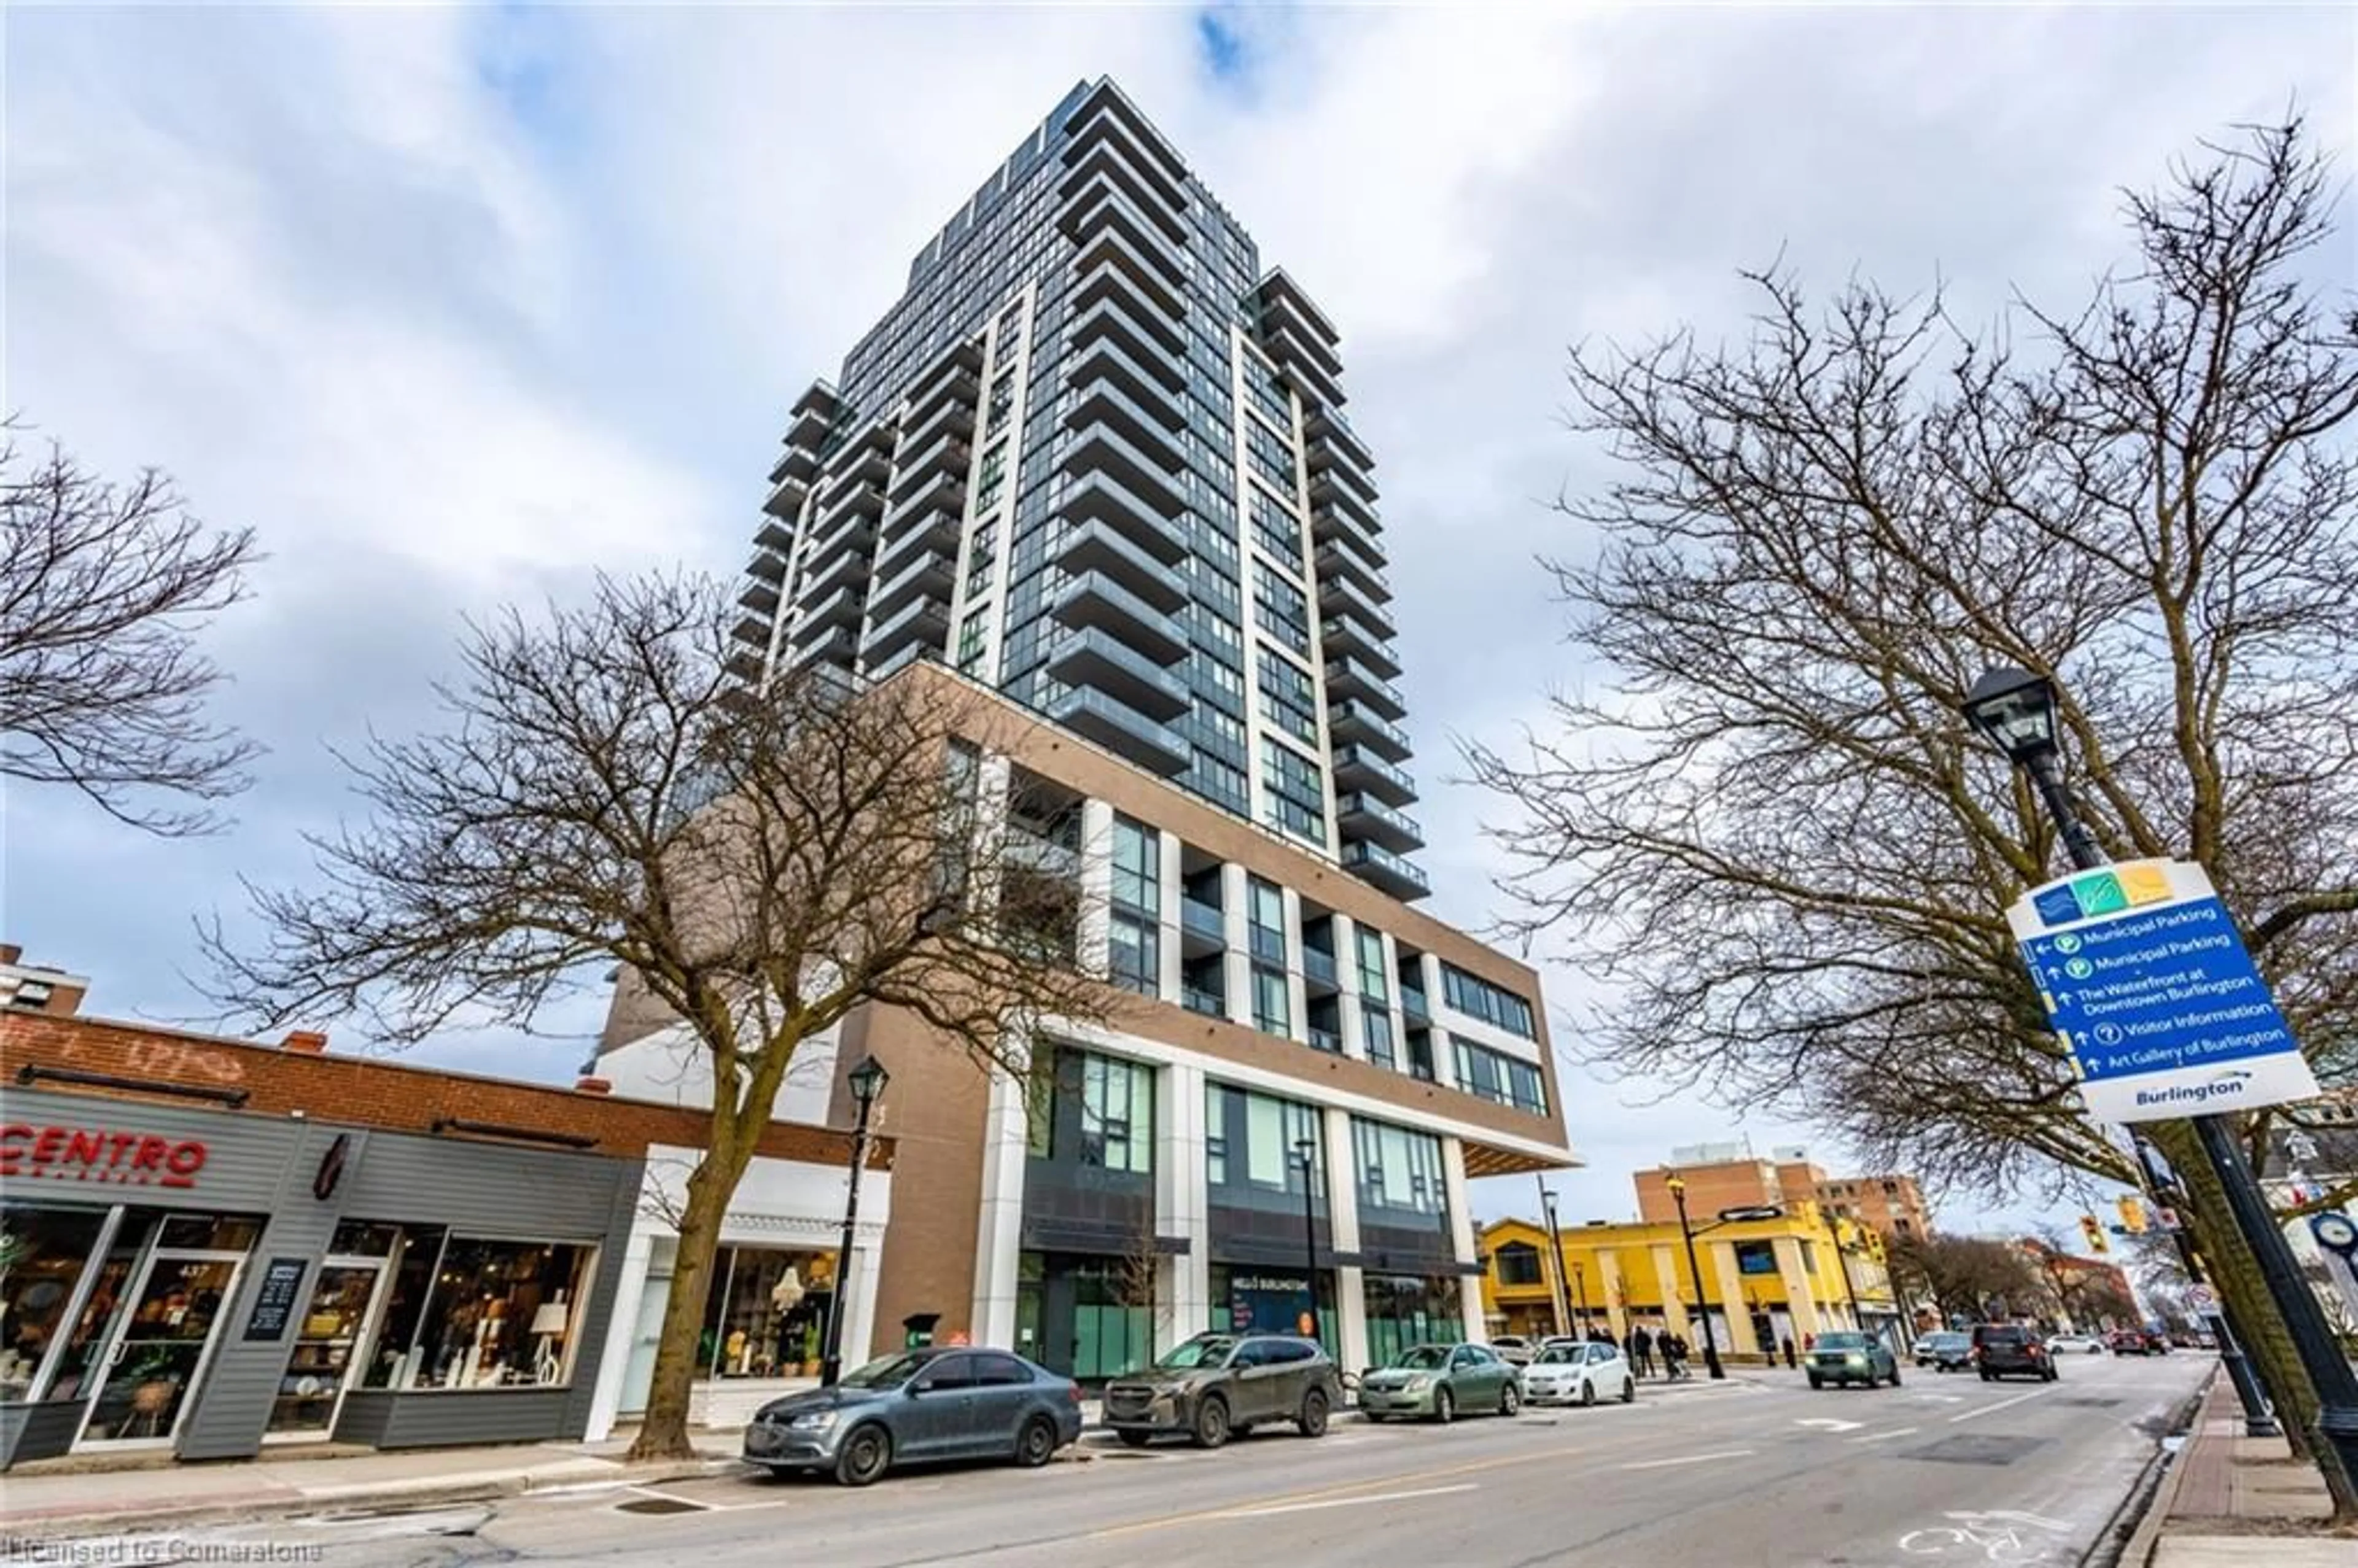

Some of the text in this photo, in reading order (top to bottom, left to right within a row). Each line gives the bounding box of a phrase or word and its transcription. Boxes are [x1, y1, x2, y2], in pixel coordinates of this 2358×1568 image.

[2083, 919, 2155, 944] Municipal
[2155, 907, 2216, 928] Parking
[2095, 945, 2166, 969] Municipal
[2168, 934, 2230, 953] Parking
[2079, 967, 2206, 1001] The Waterfront at
[2084, 975, 2255, 1016] Downtown Burlington
[2123, 1020, 2173, 1036] Visitor
[2173, 1002, 2273, 1028] Information
[2108, 1027, 2286, 1069] Art Gallery of Burlington
[2136, 1080, 2243, 1106] Burlington
[0, 1121, 210, 1175] CENTRO
